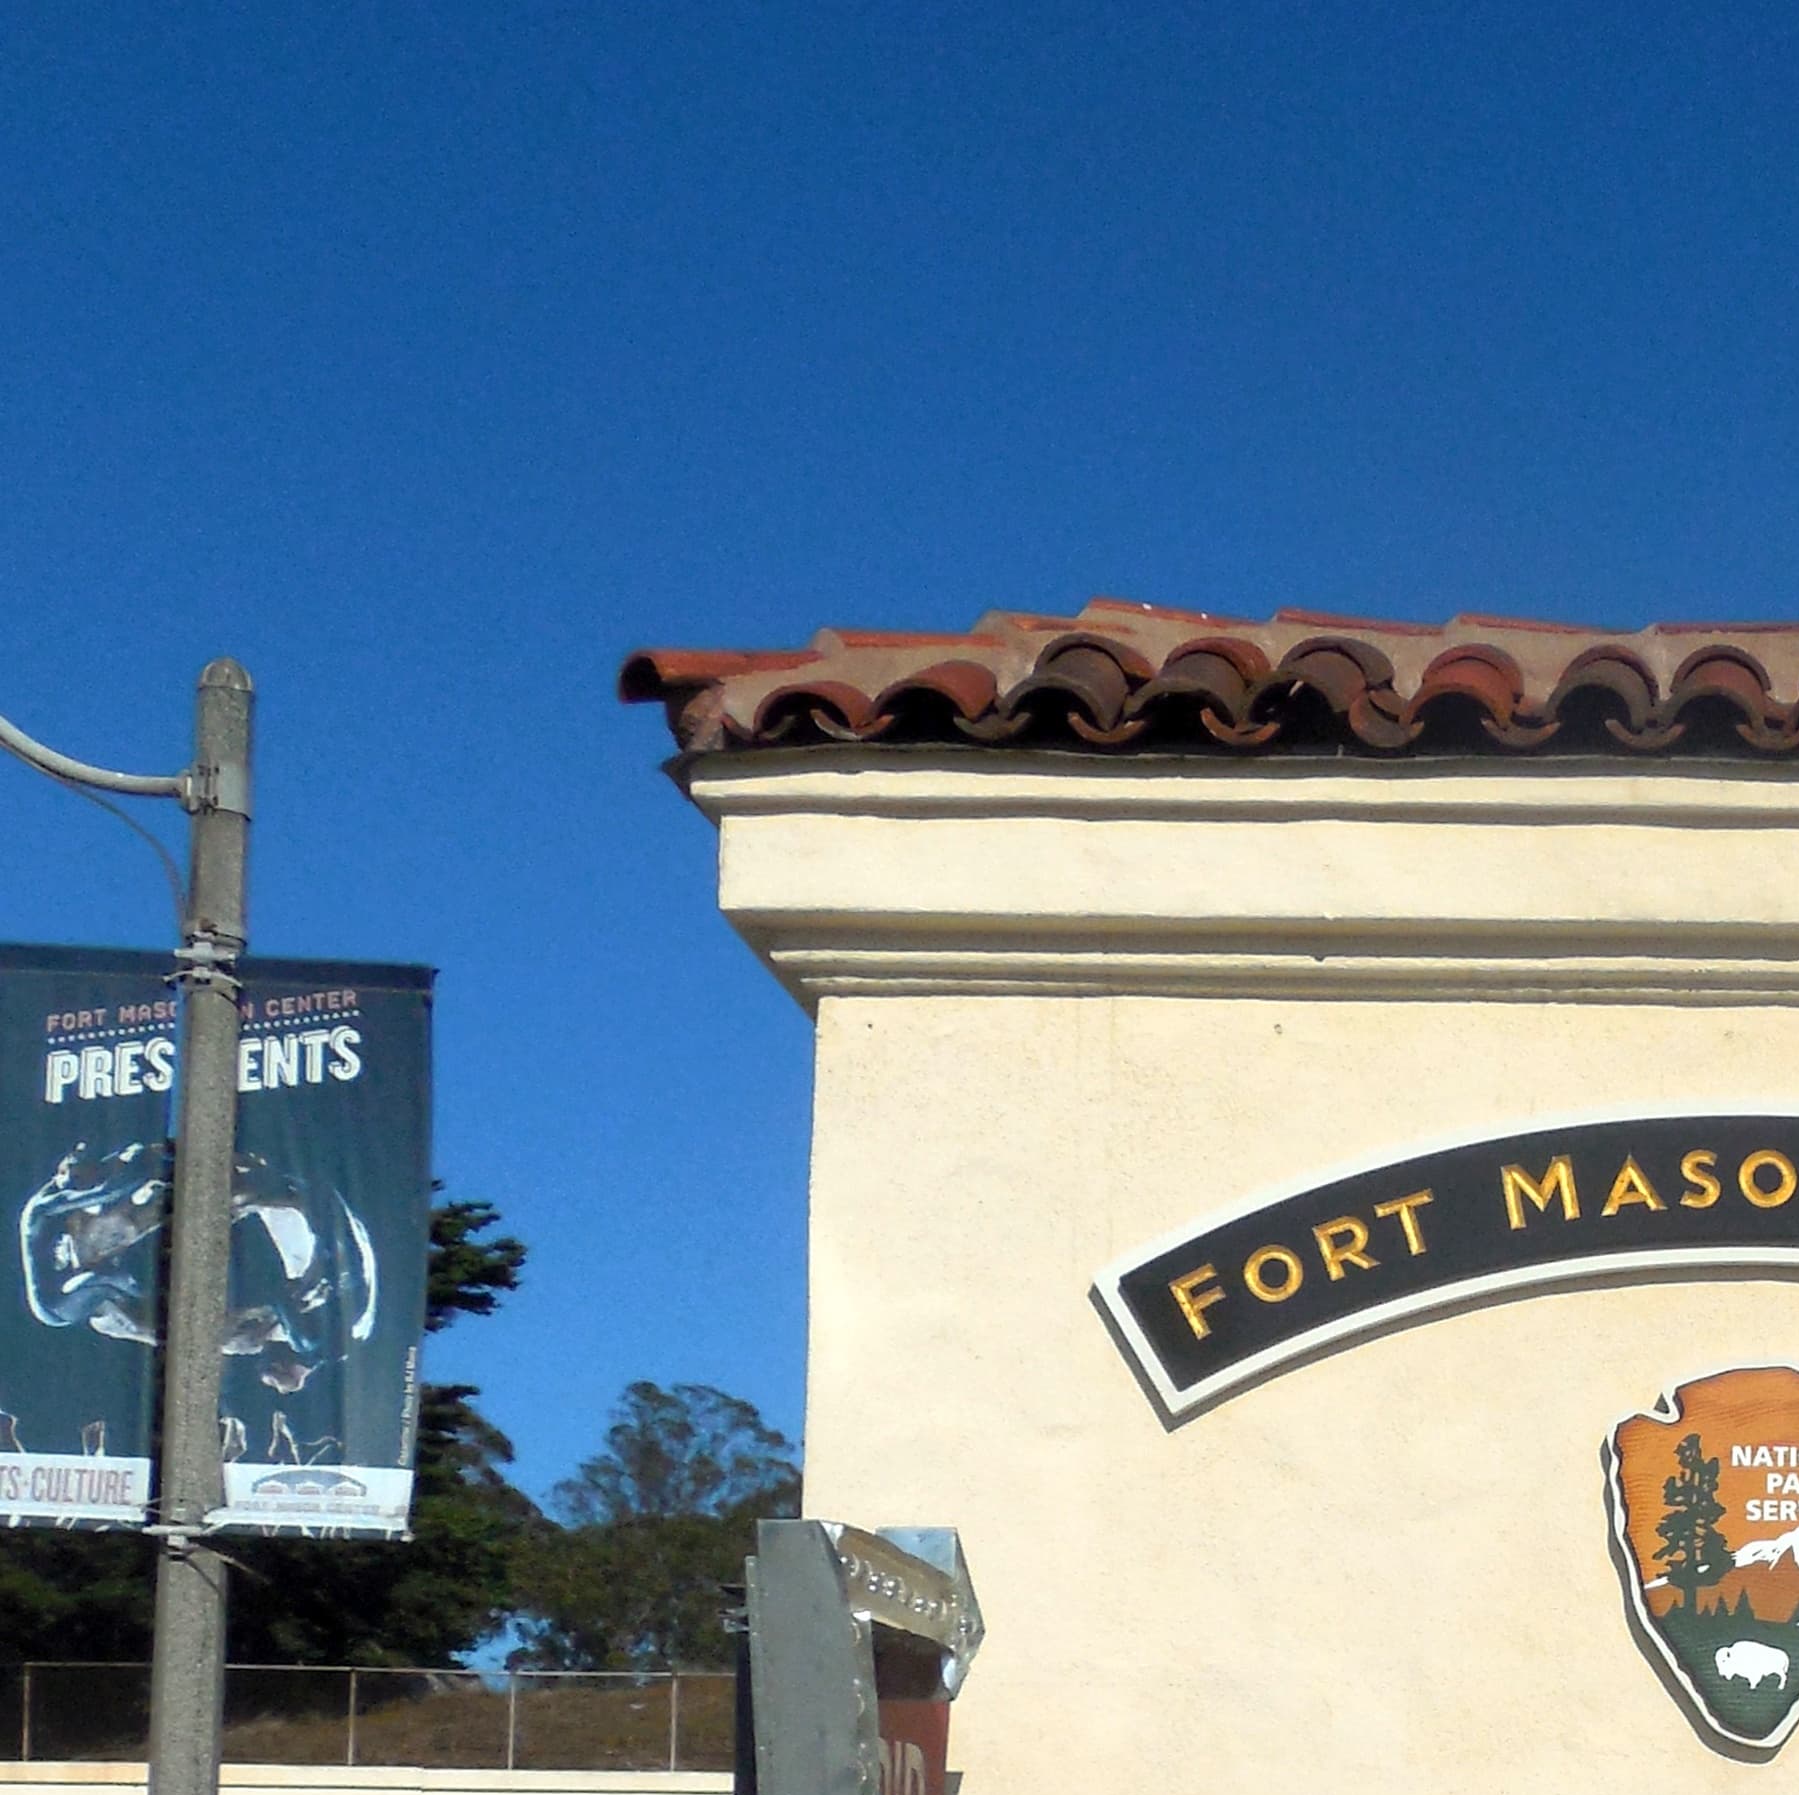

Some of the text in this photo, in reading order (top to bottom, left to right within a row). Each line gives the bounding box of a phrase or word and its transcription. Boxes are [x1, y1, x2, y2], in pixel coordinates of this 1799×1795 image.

[46, 1007, 108, 1033] FORT
[265, 989, 358, 1018] CENTER
[1166, 1187, 1435, 1341] FORT
